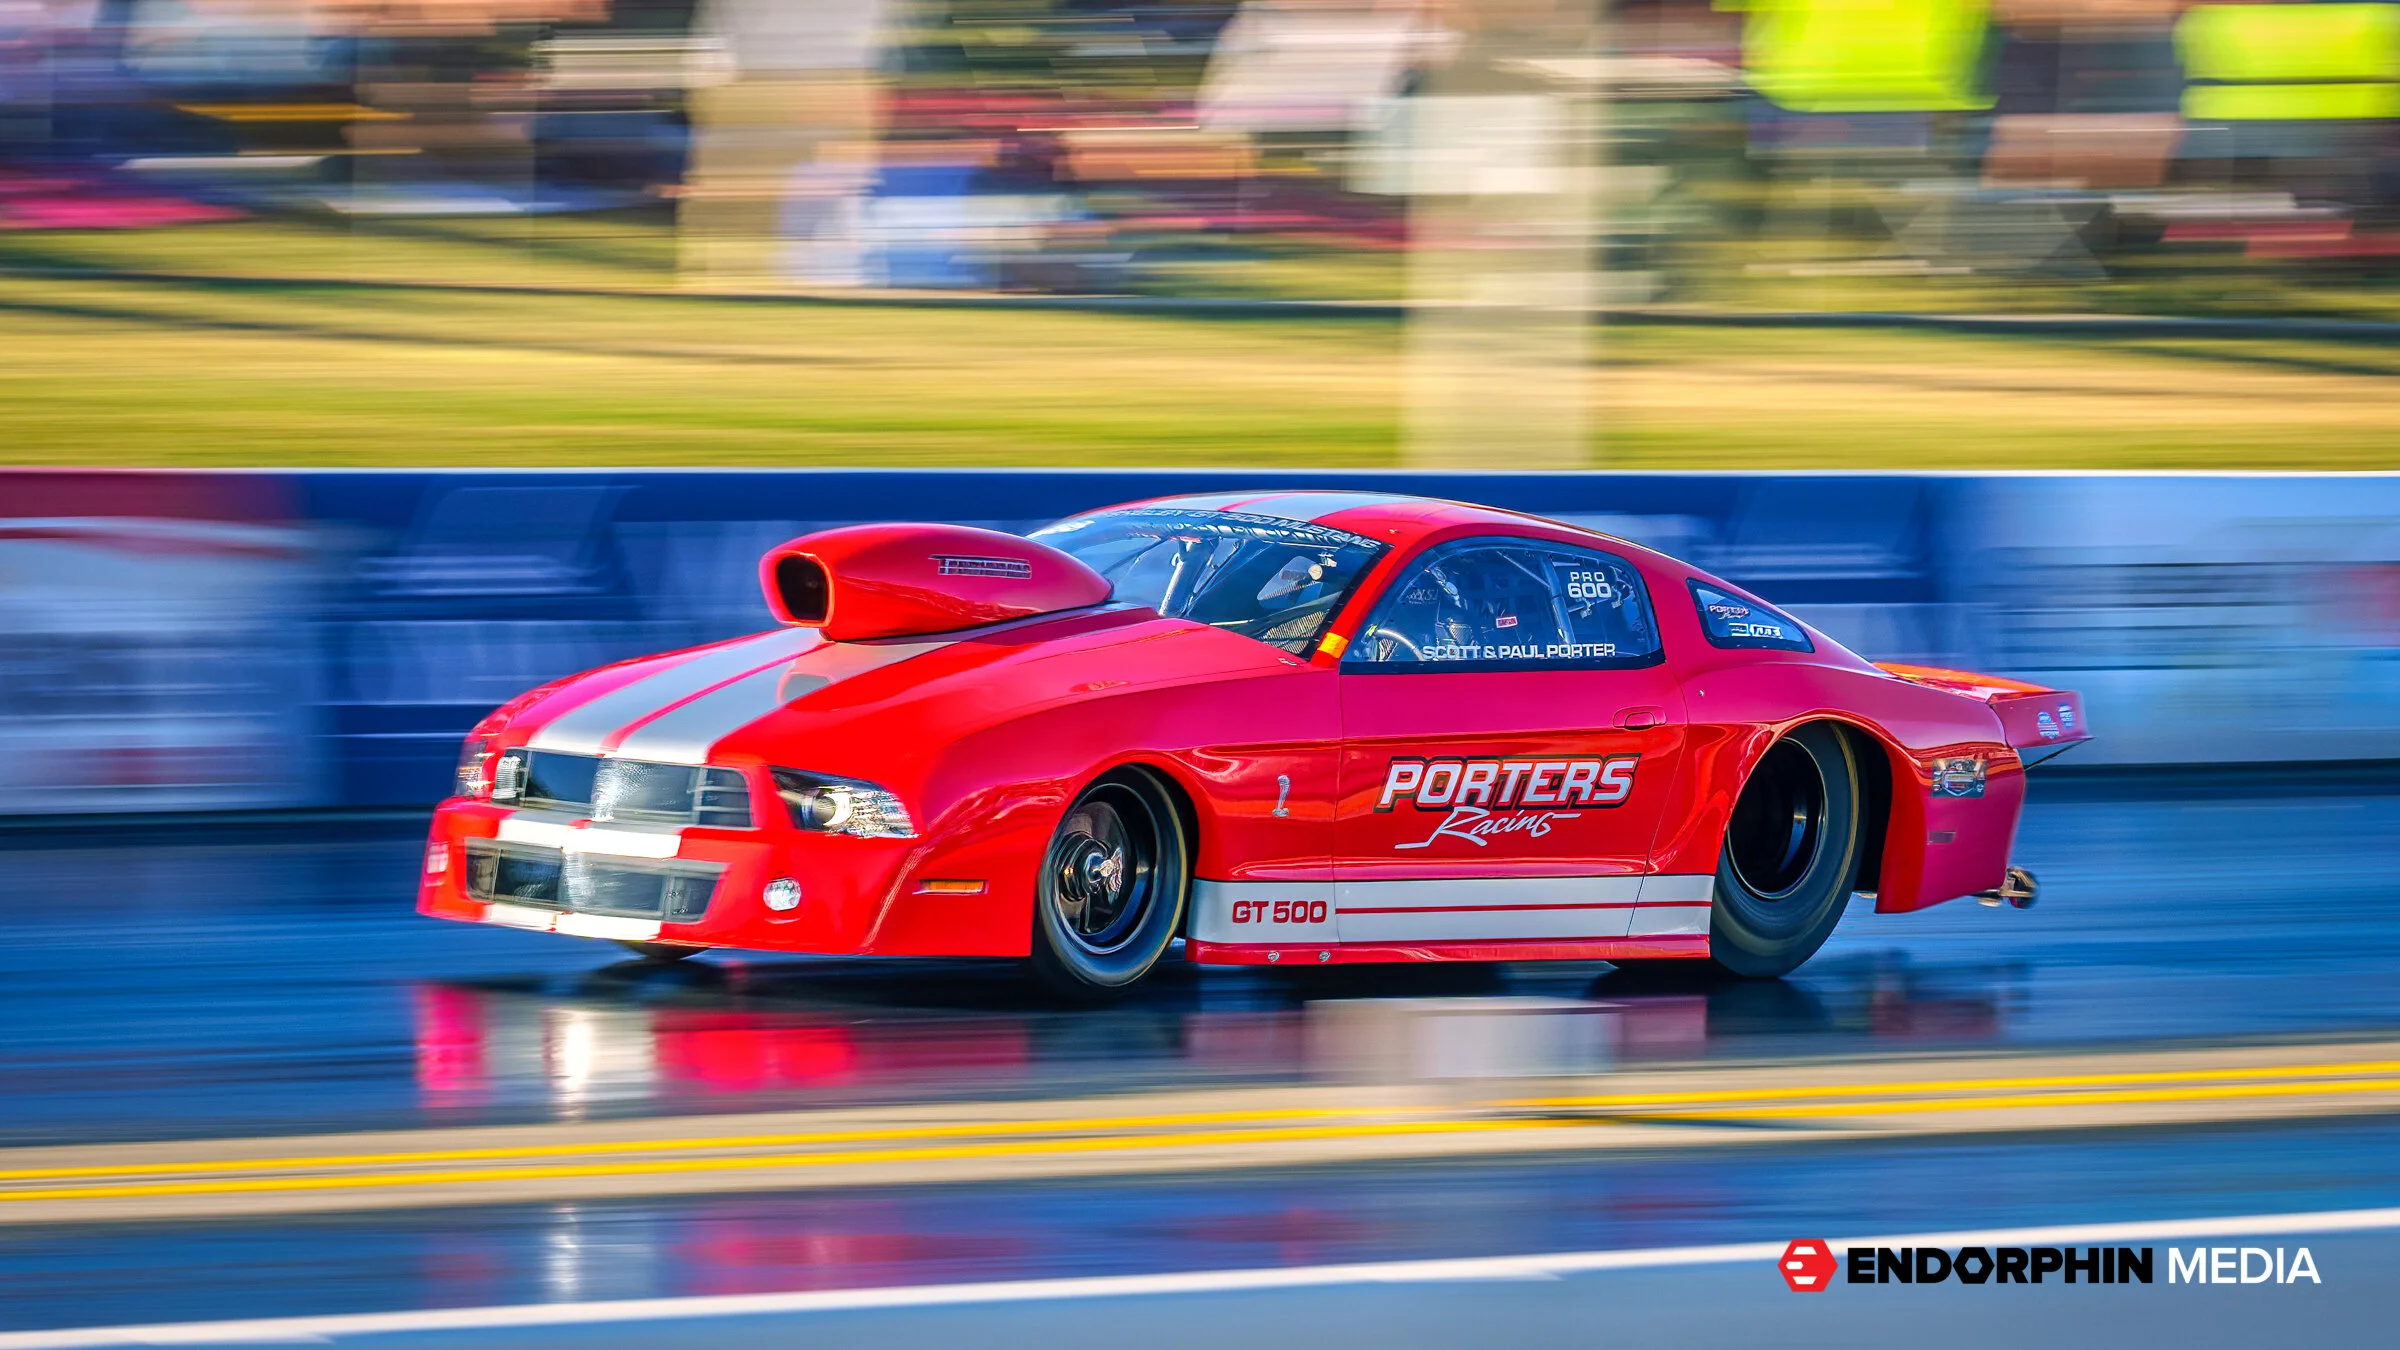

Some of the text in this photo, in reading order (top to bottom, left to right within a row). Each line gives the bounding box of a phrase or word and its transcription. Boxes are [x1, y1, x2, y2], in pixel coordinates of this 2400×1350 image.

[1569, 572, 1605, 582] PRO
[1567, 583, 1612, 598] 600
[1422, 643, 1616, 659] SCOTT & PAUL PORTER
[1376, 755, 1639, 810] PORTERS
[1232, 900, 1328, 924] GT 500
